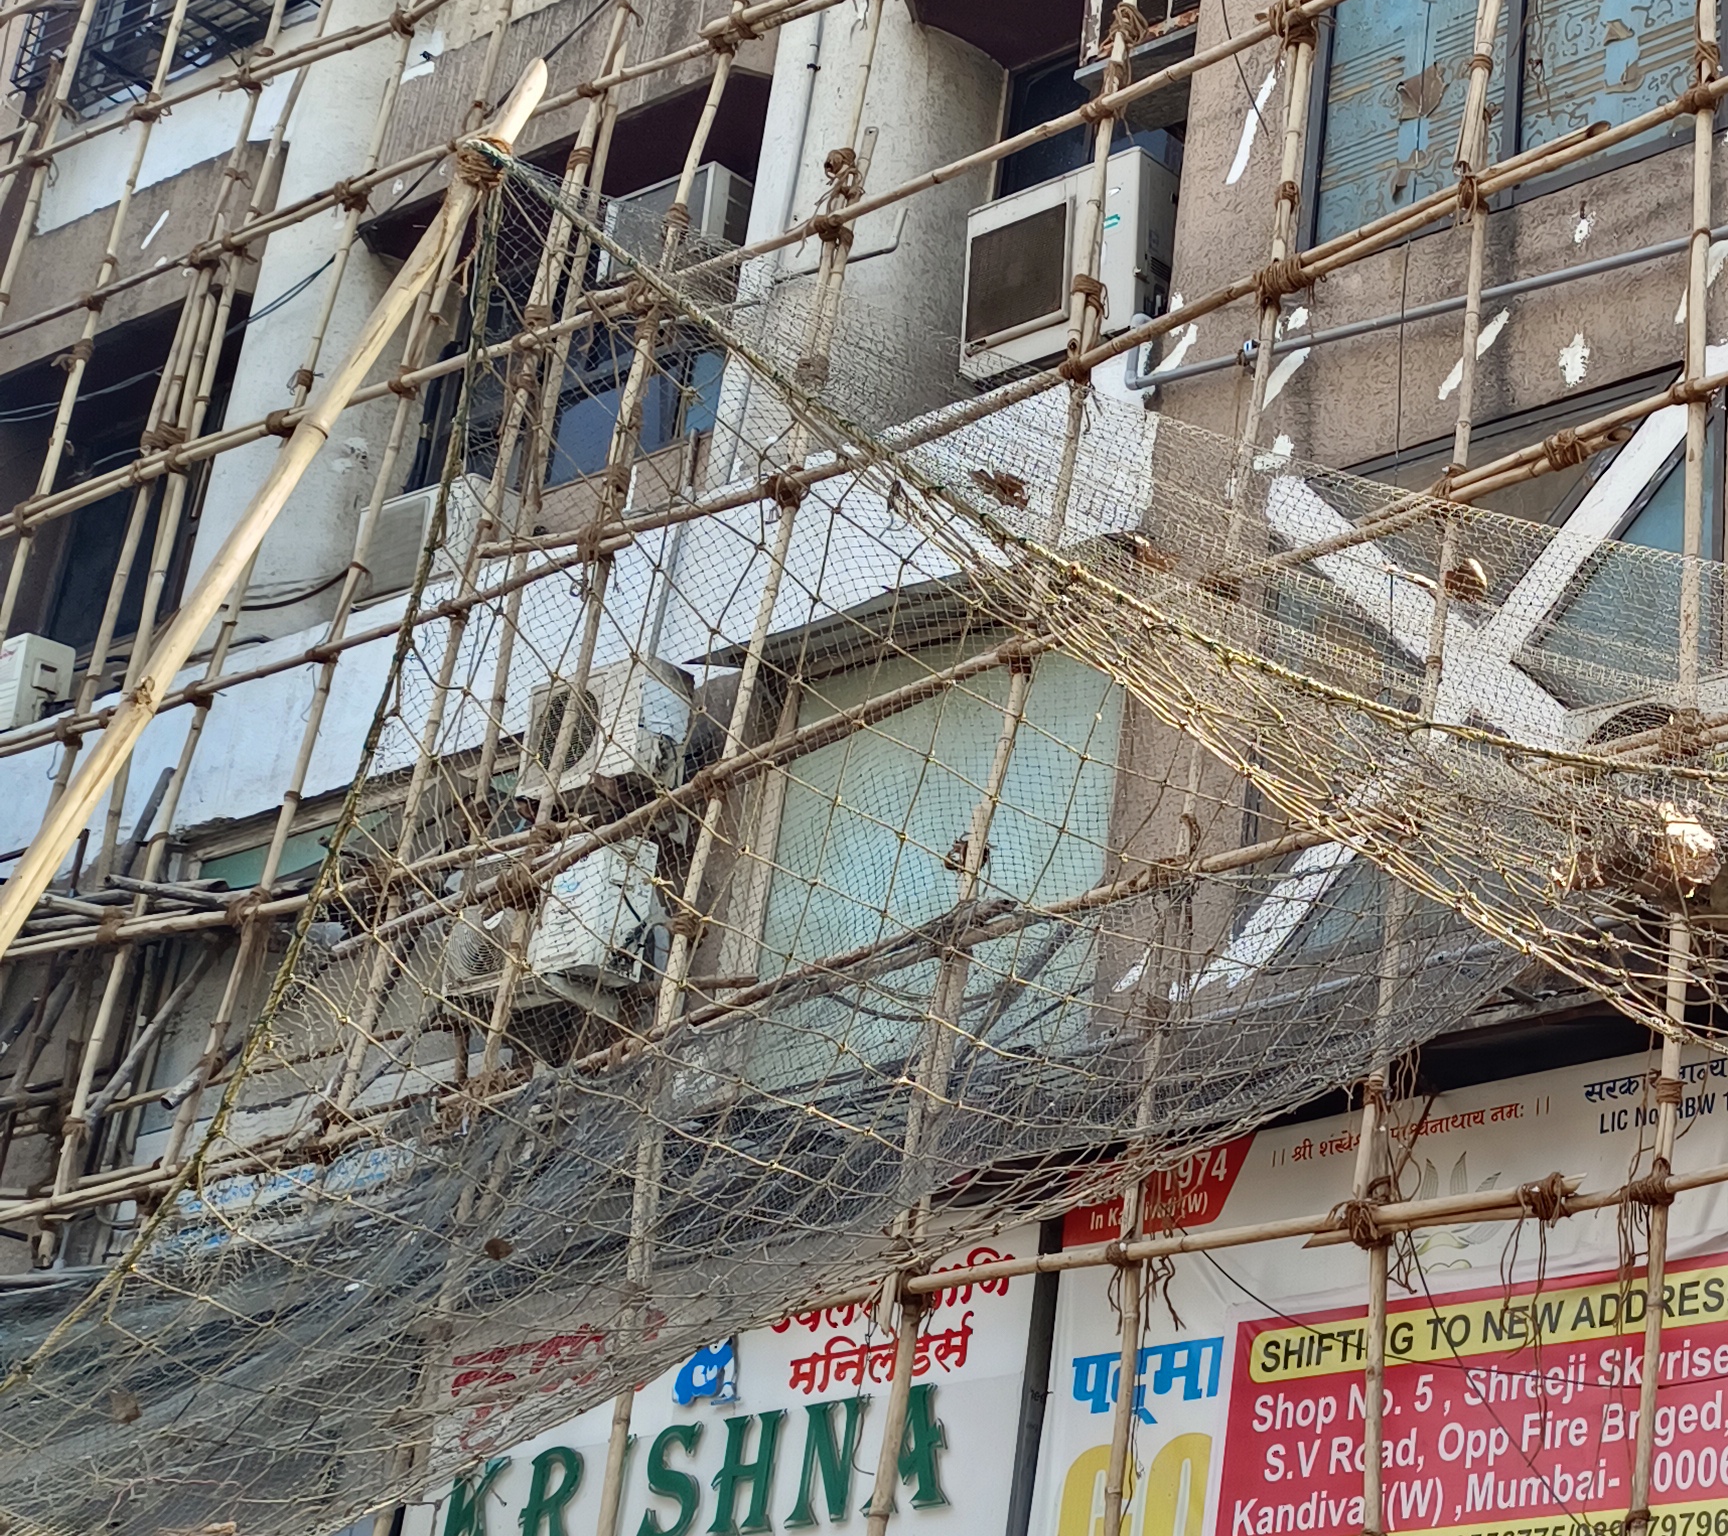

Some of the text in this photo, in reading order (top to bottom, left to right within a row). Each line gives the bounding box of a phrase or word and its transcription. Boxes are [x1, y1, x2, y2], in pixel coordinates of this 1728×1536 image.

[1600, 1109, 1628, 1134] LIC
[1165, 1148, 1227, 1191] 1974
[1090, 1211, 1103, 1230] In
[1261, 1322, 1413, 1373] SHIFTIG
[1427, 1314, 1470, 1351] TO
[1482, 1300, 1564, 1343] NEW
[1252, 1392, 1337, 1434] Shop
[1464, 1353, 1586, 1406] Shreeji
[1264, 1438, 1321, 1482] S.V
[1438, 1422, 1509, 1469] Opp
[1521, 1411, 1588, 1453] Fire
